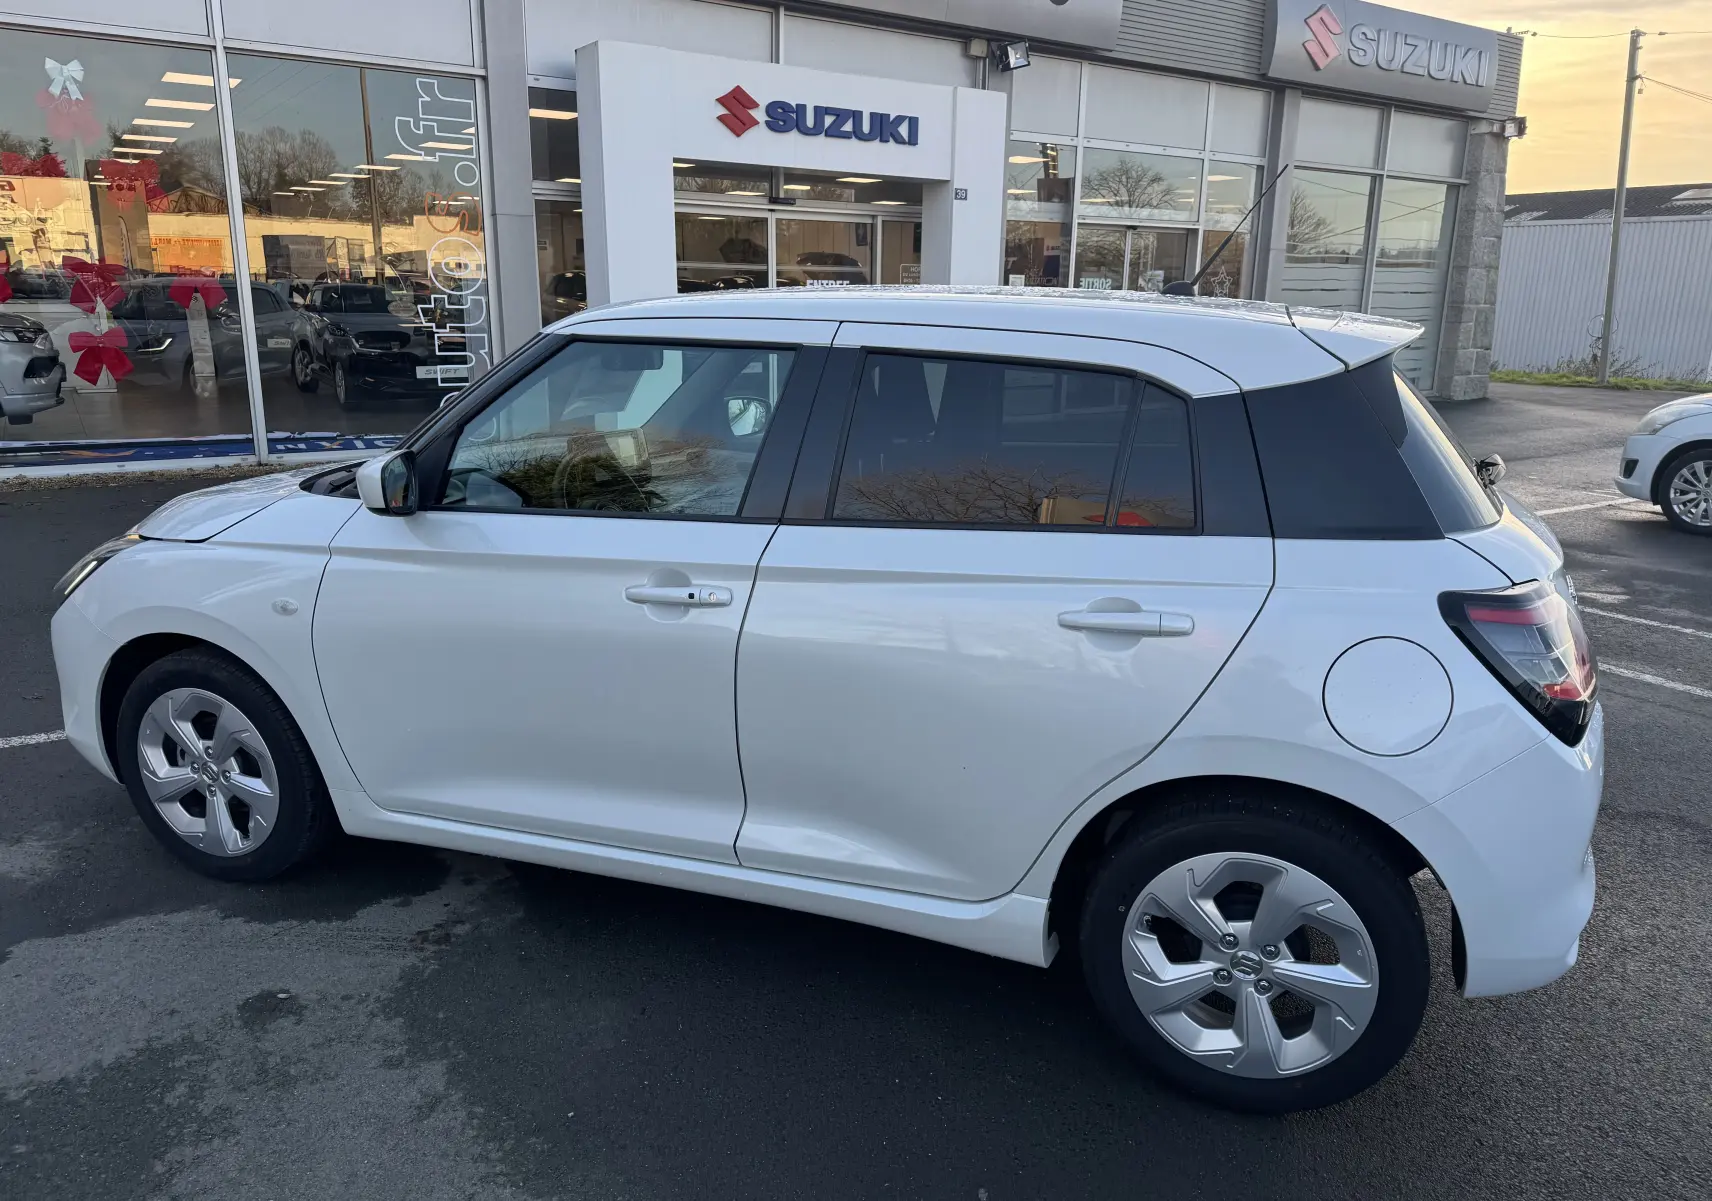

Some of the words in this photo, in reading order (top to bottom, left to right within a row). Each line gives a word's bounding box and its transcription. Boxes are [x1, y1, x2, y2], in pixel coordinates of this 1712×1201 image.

[1348, 23, 1490, 87] SUZUKI
[765, 100, 919, 146] SUZUKI
[956, 189, 966, 199] 39
[394, 78, 490, 410] utos.fr
[424, 368, 460, 376] SWIFT
